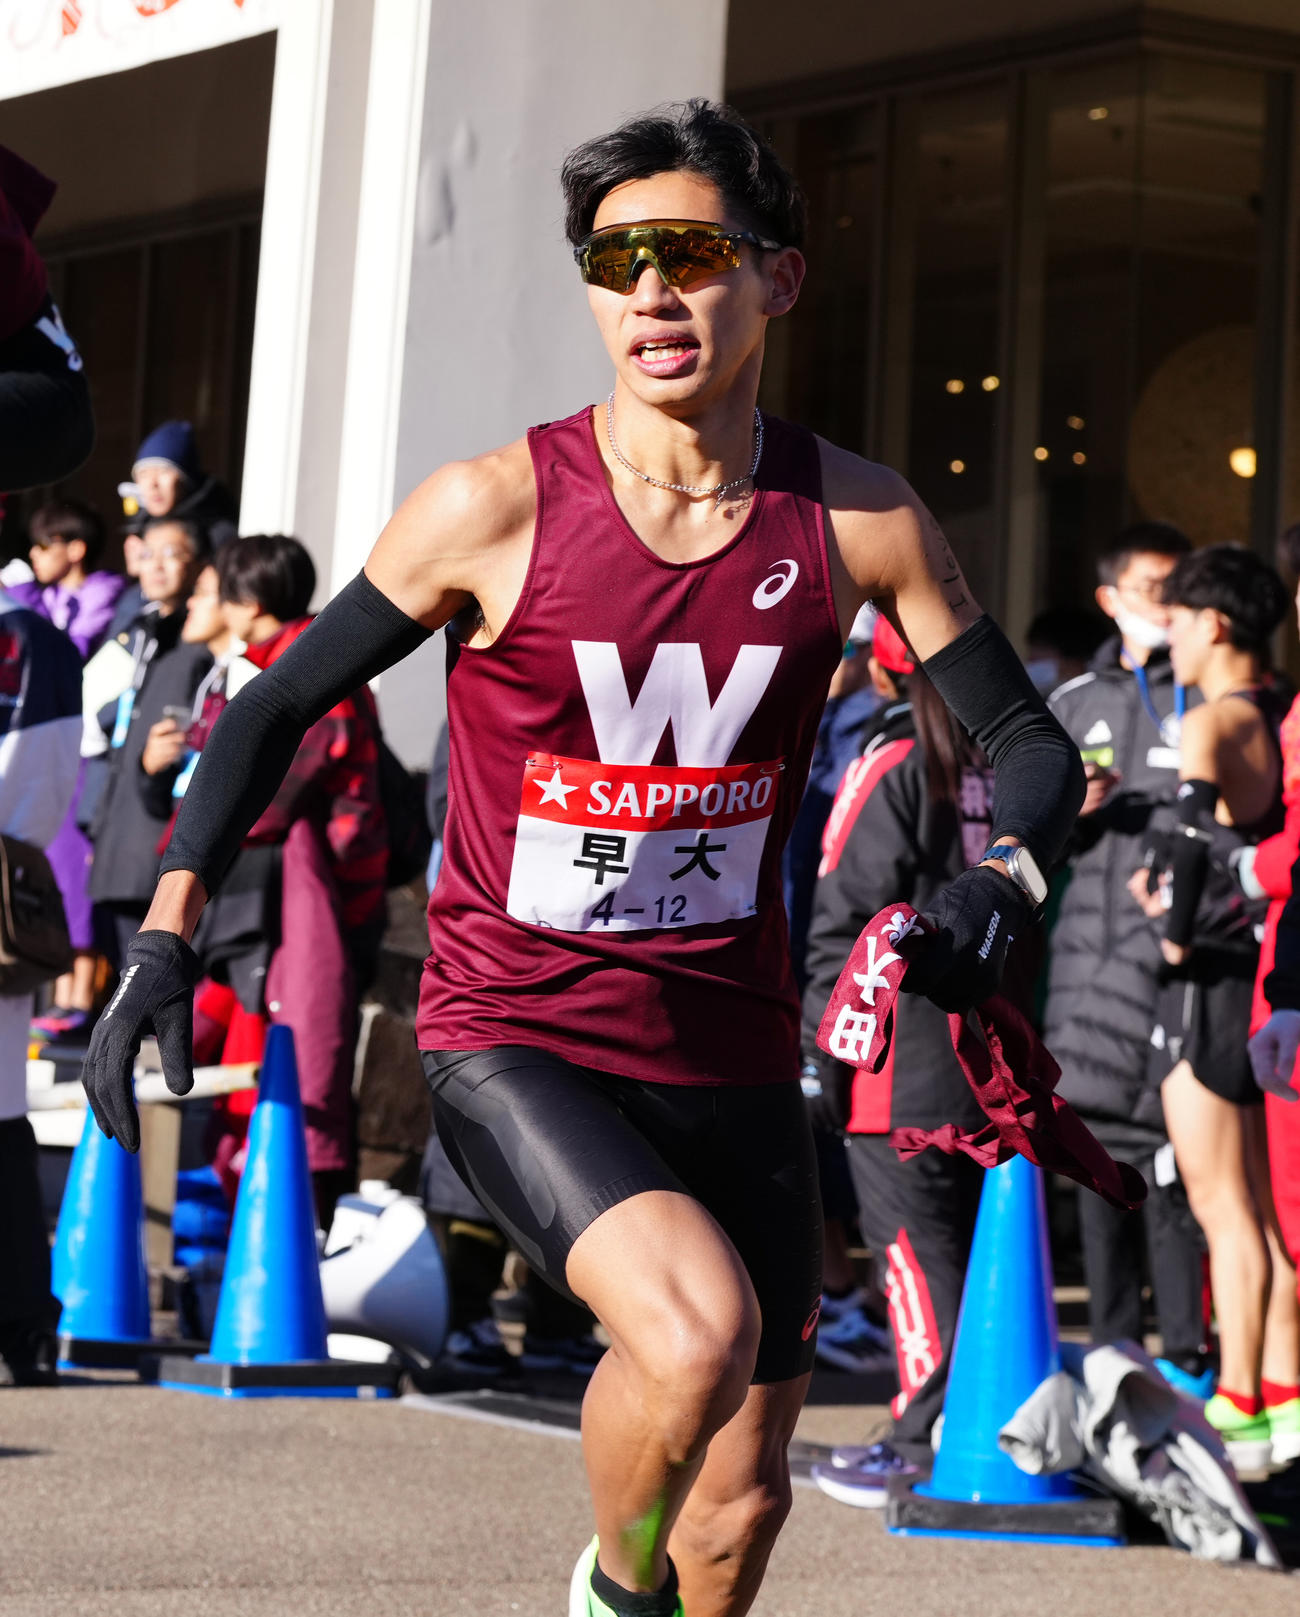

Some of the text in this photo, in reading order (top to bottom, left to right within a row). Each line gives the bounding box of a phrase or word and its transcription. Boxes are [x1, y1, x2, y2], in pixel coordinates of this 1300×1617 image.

[571, 640, 784, 767] W
[586, 776, 773, 818] SAPPORO
[977, 910, 1001, 960] WASEDA
